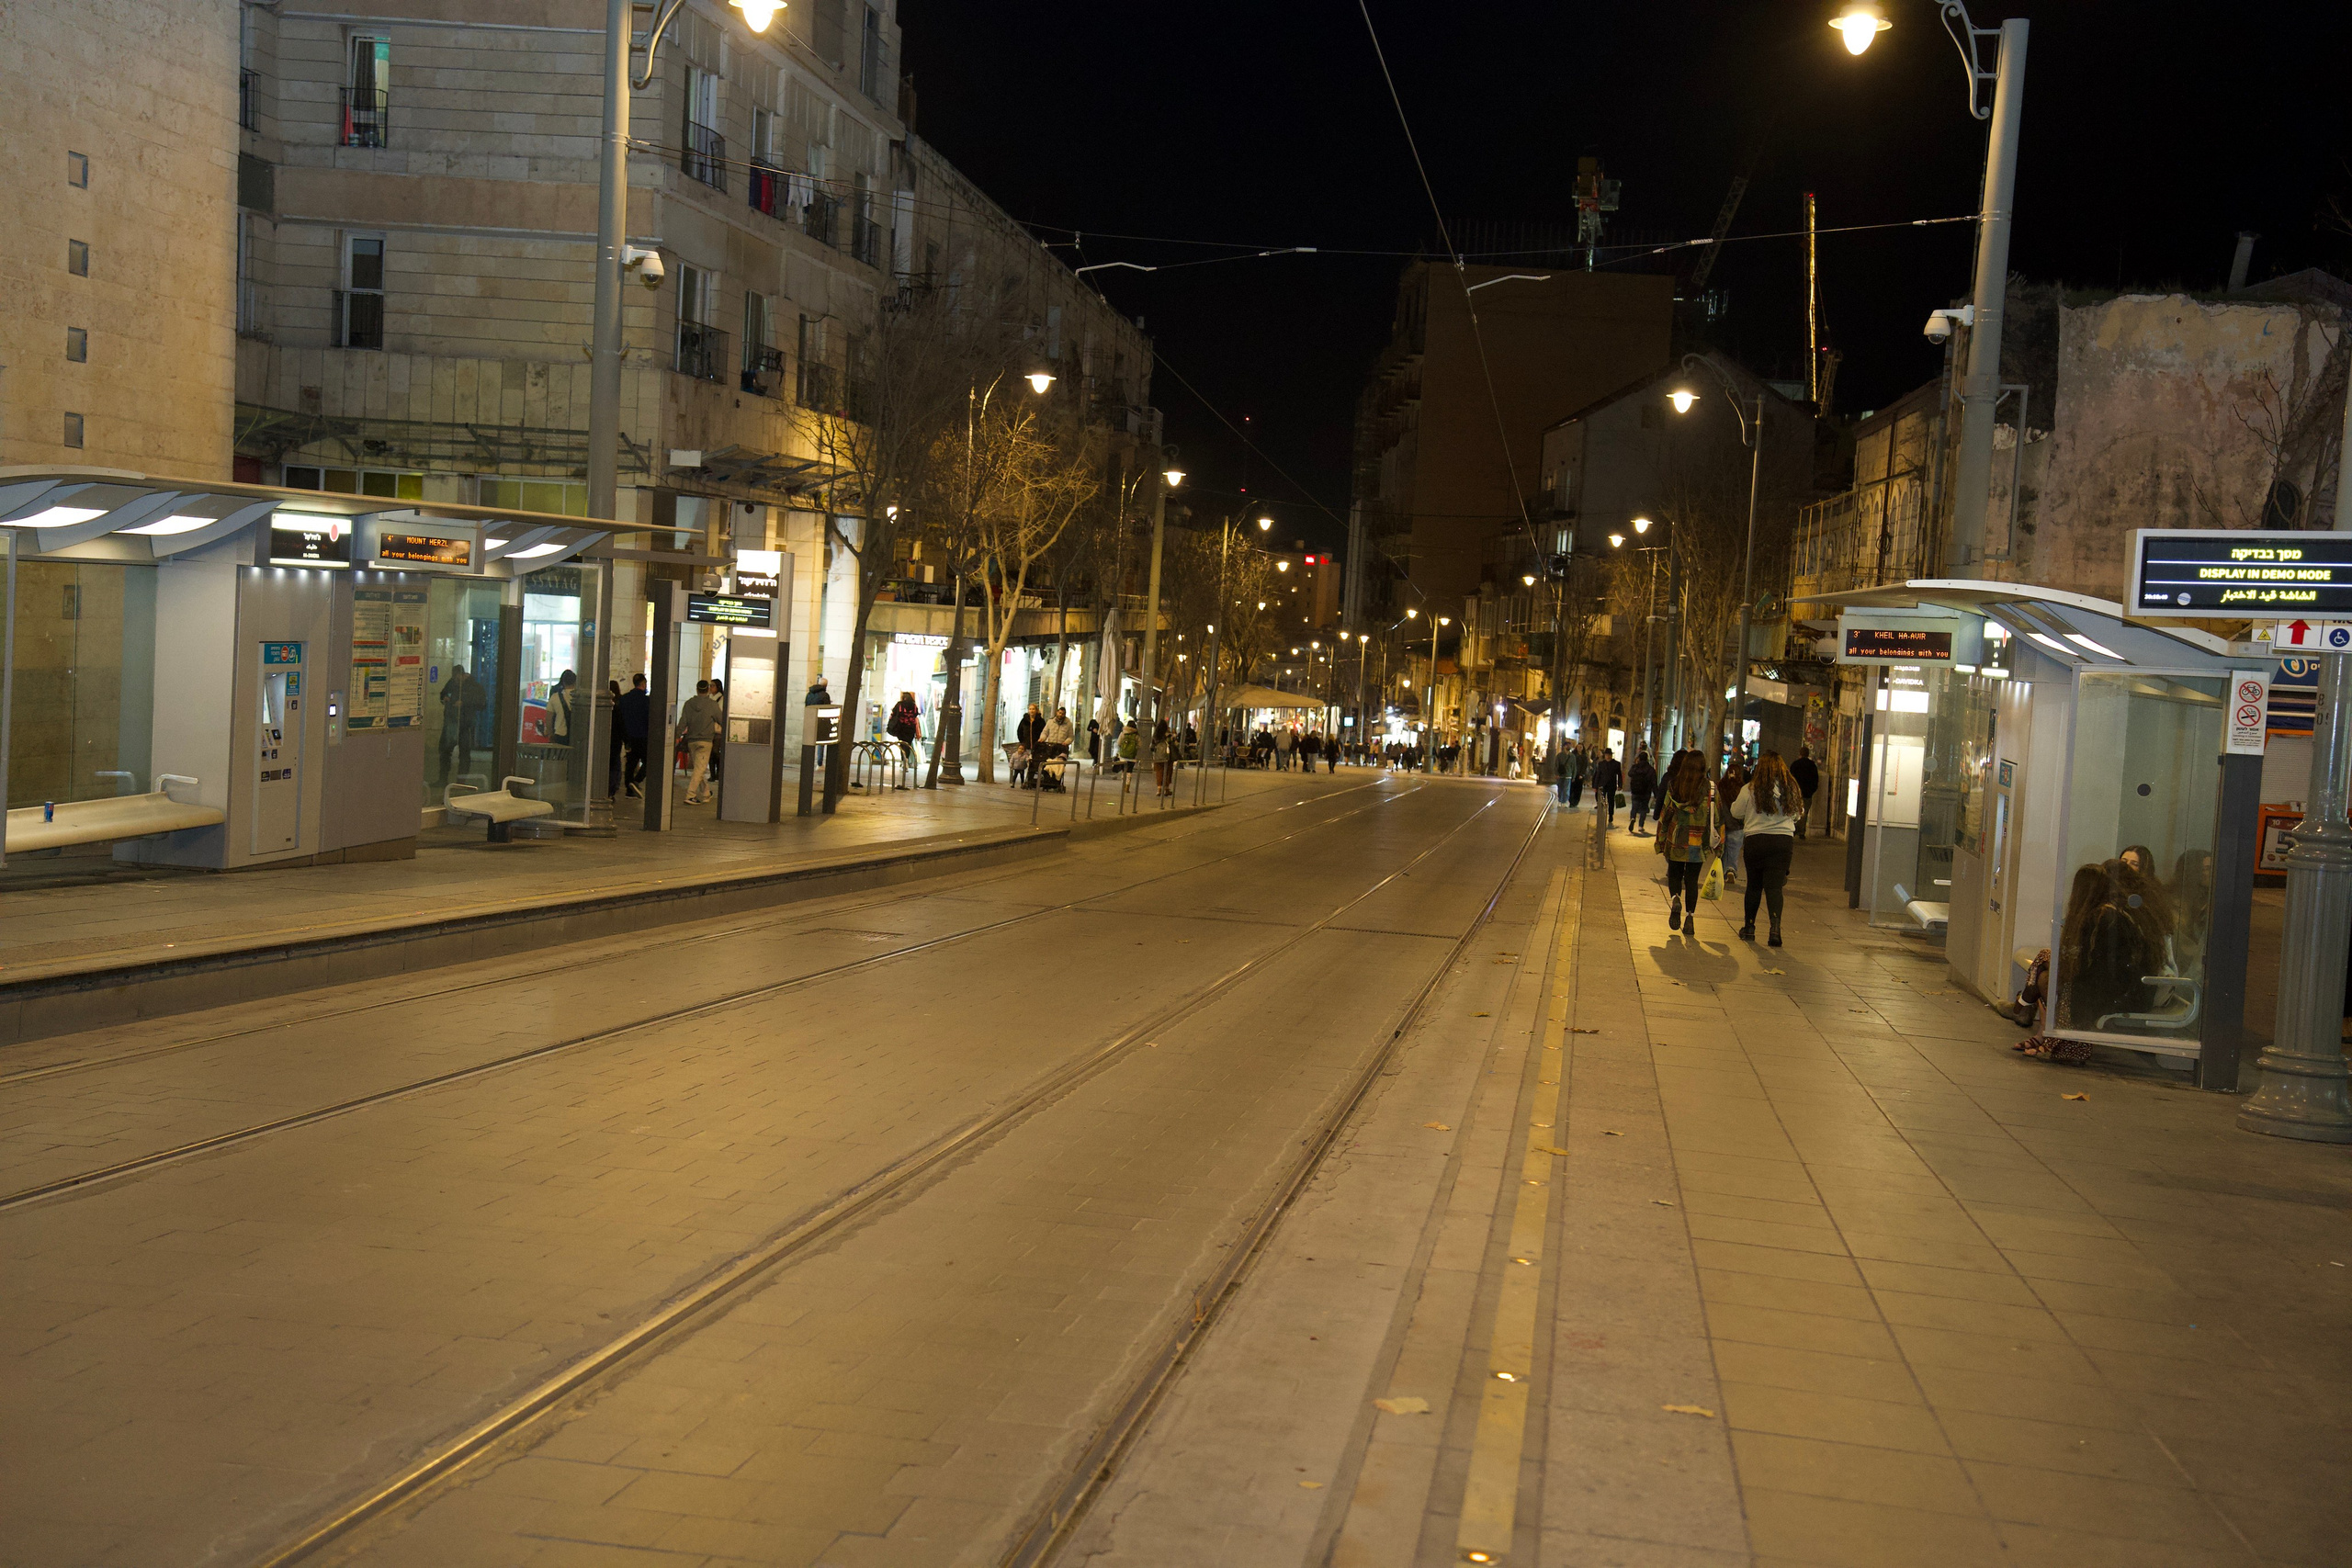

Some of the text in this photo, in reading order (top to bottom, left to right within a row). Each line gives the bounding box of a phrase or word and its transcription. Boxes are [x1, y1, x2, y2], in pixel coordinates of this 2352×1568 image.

[406, 536, 426, 545] MOUNT
[429, 538, 449, 547] HERZL
[391, 551, 405, 559] your
[408, 551, 438, 561] belongings
[2232, 549, 2302, 561] מסך בבדיקה
[2199, 569, 2331, 581] DISPLAY IN DEMO MODE
[2221, 590, 2316, 603] الشاشة قيد الاختبار
[1874, 631, 1894, 639] KHEIL
[1918, 649, 1932, 658] with
[1936, 649, 1949, 658] you
[1884, 677, 1924, 685] H-DAVIDKA
